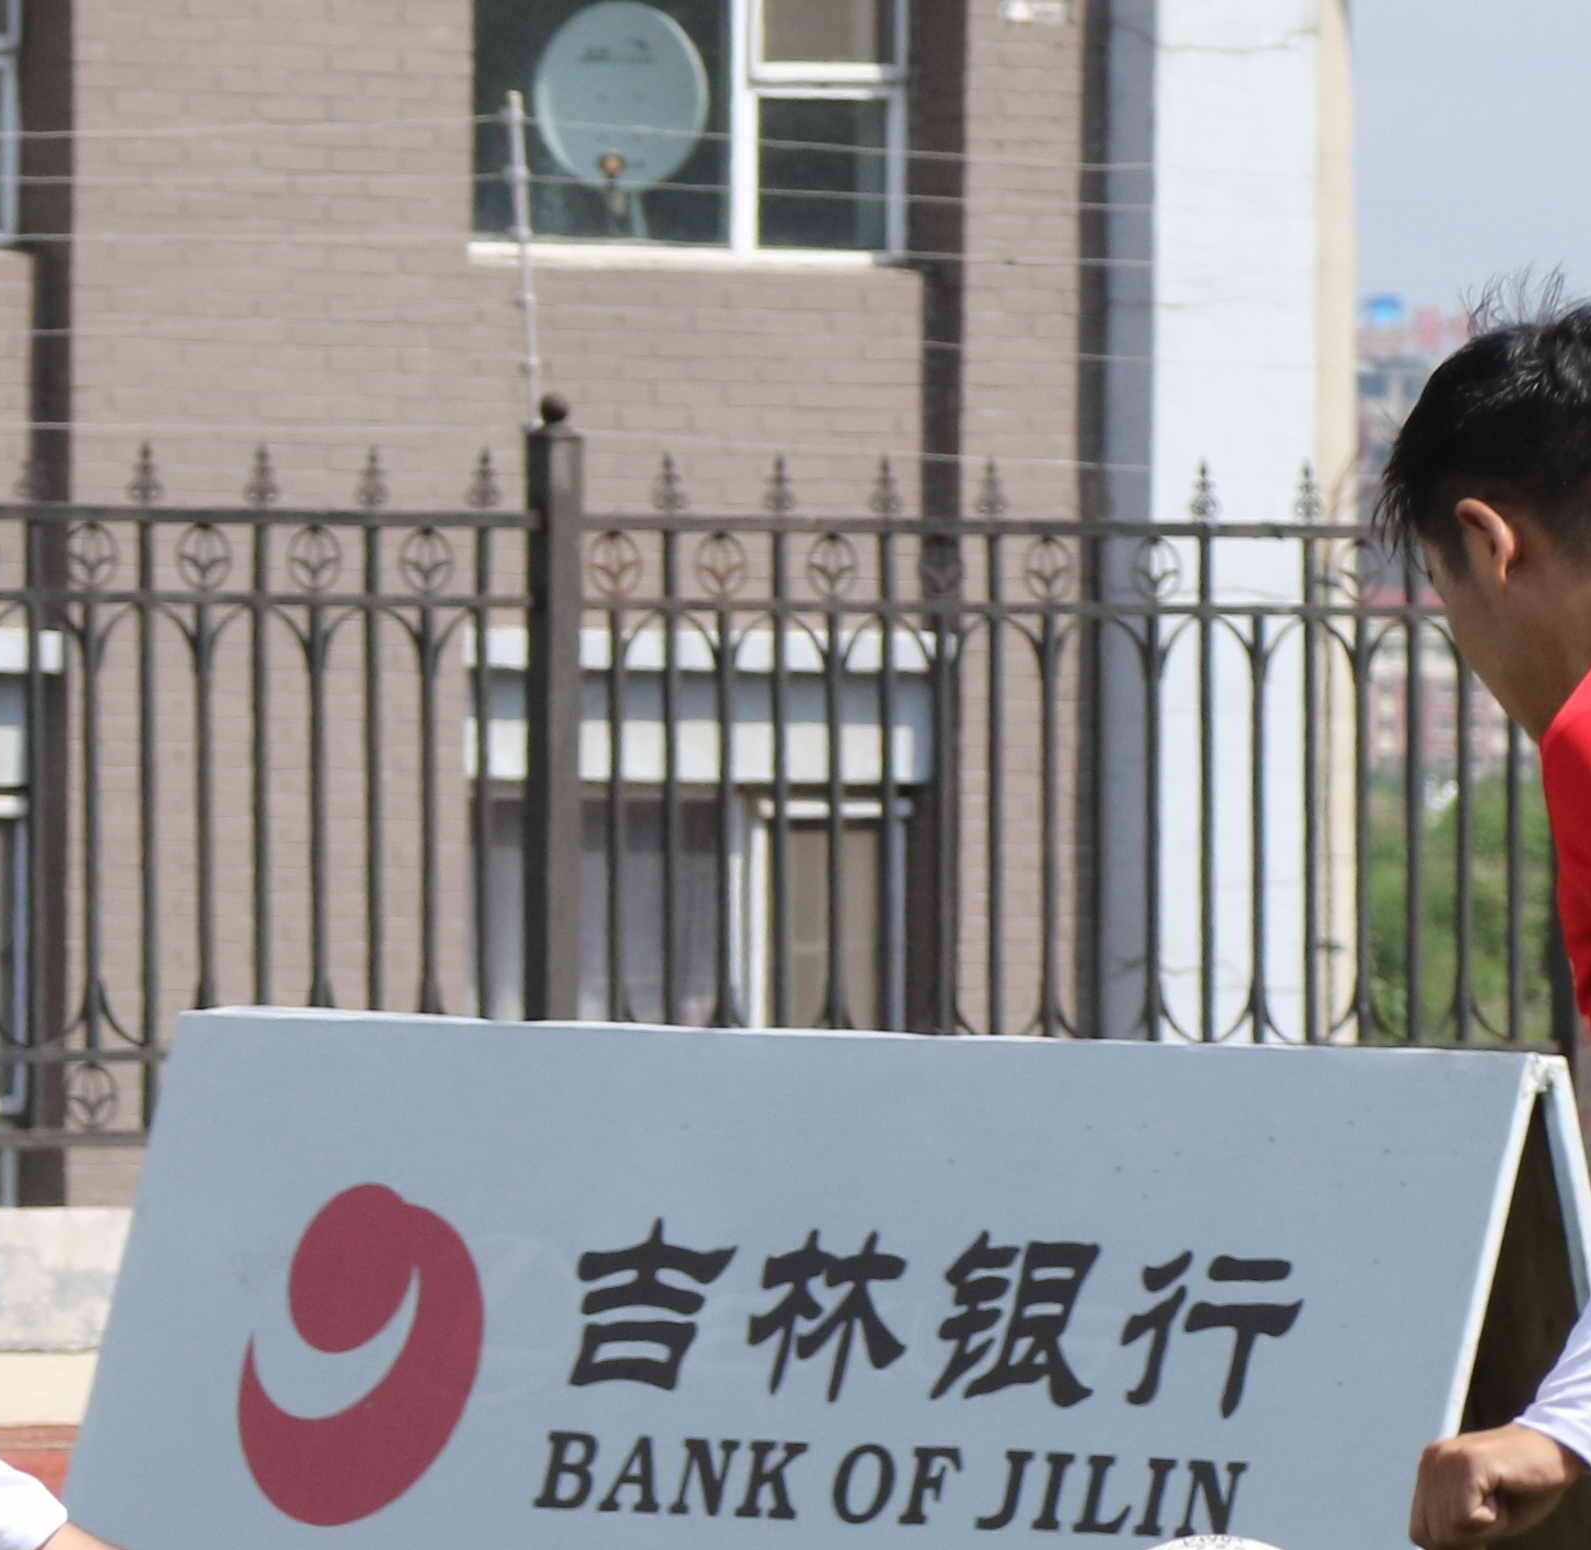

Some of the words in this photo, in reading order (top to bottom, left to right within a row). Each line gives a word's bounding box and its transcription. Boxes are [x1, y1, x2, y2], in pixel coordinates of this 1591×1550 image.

[568, 1217, 1304, 1420] 吉林银行
[534, 1431, 808, 1520] BANK
[831, 1443, 963, 1526] OF
[975, 1449, 1249, 1538] JILIN
